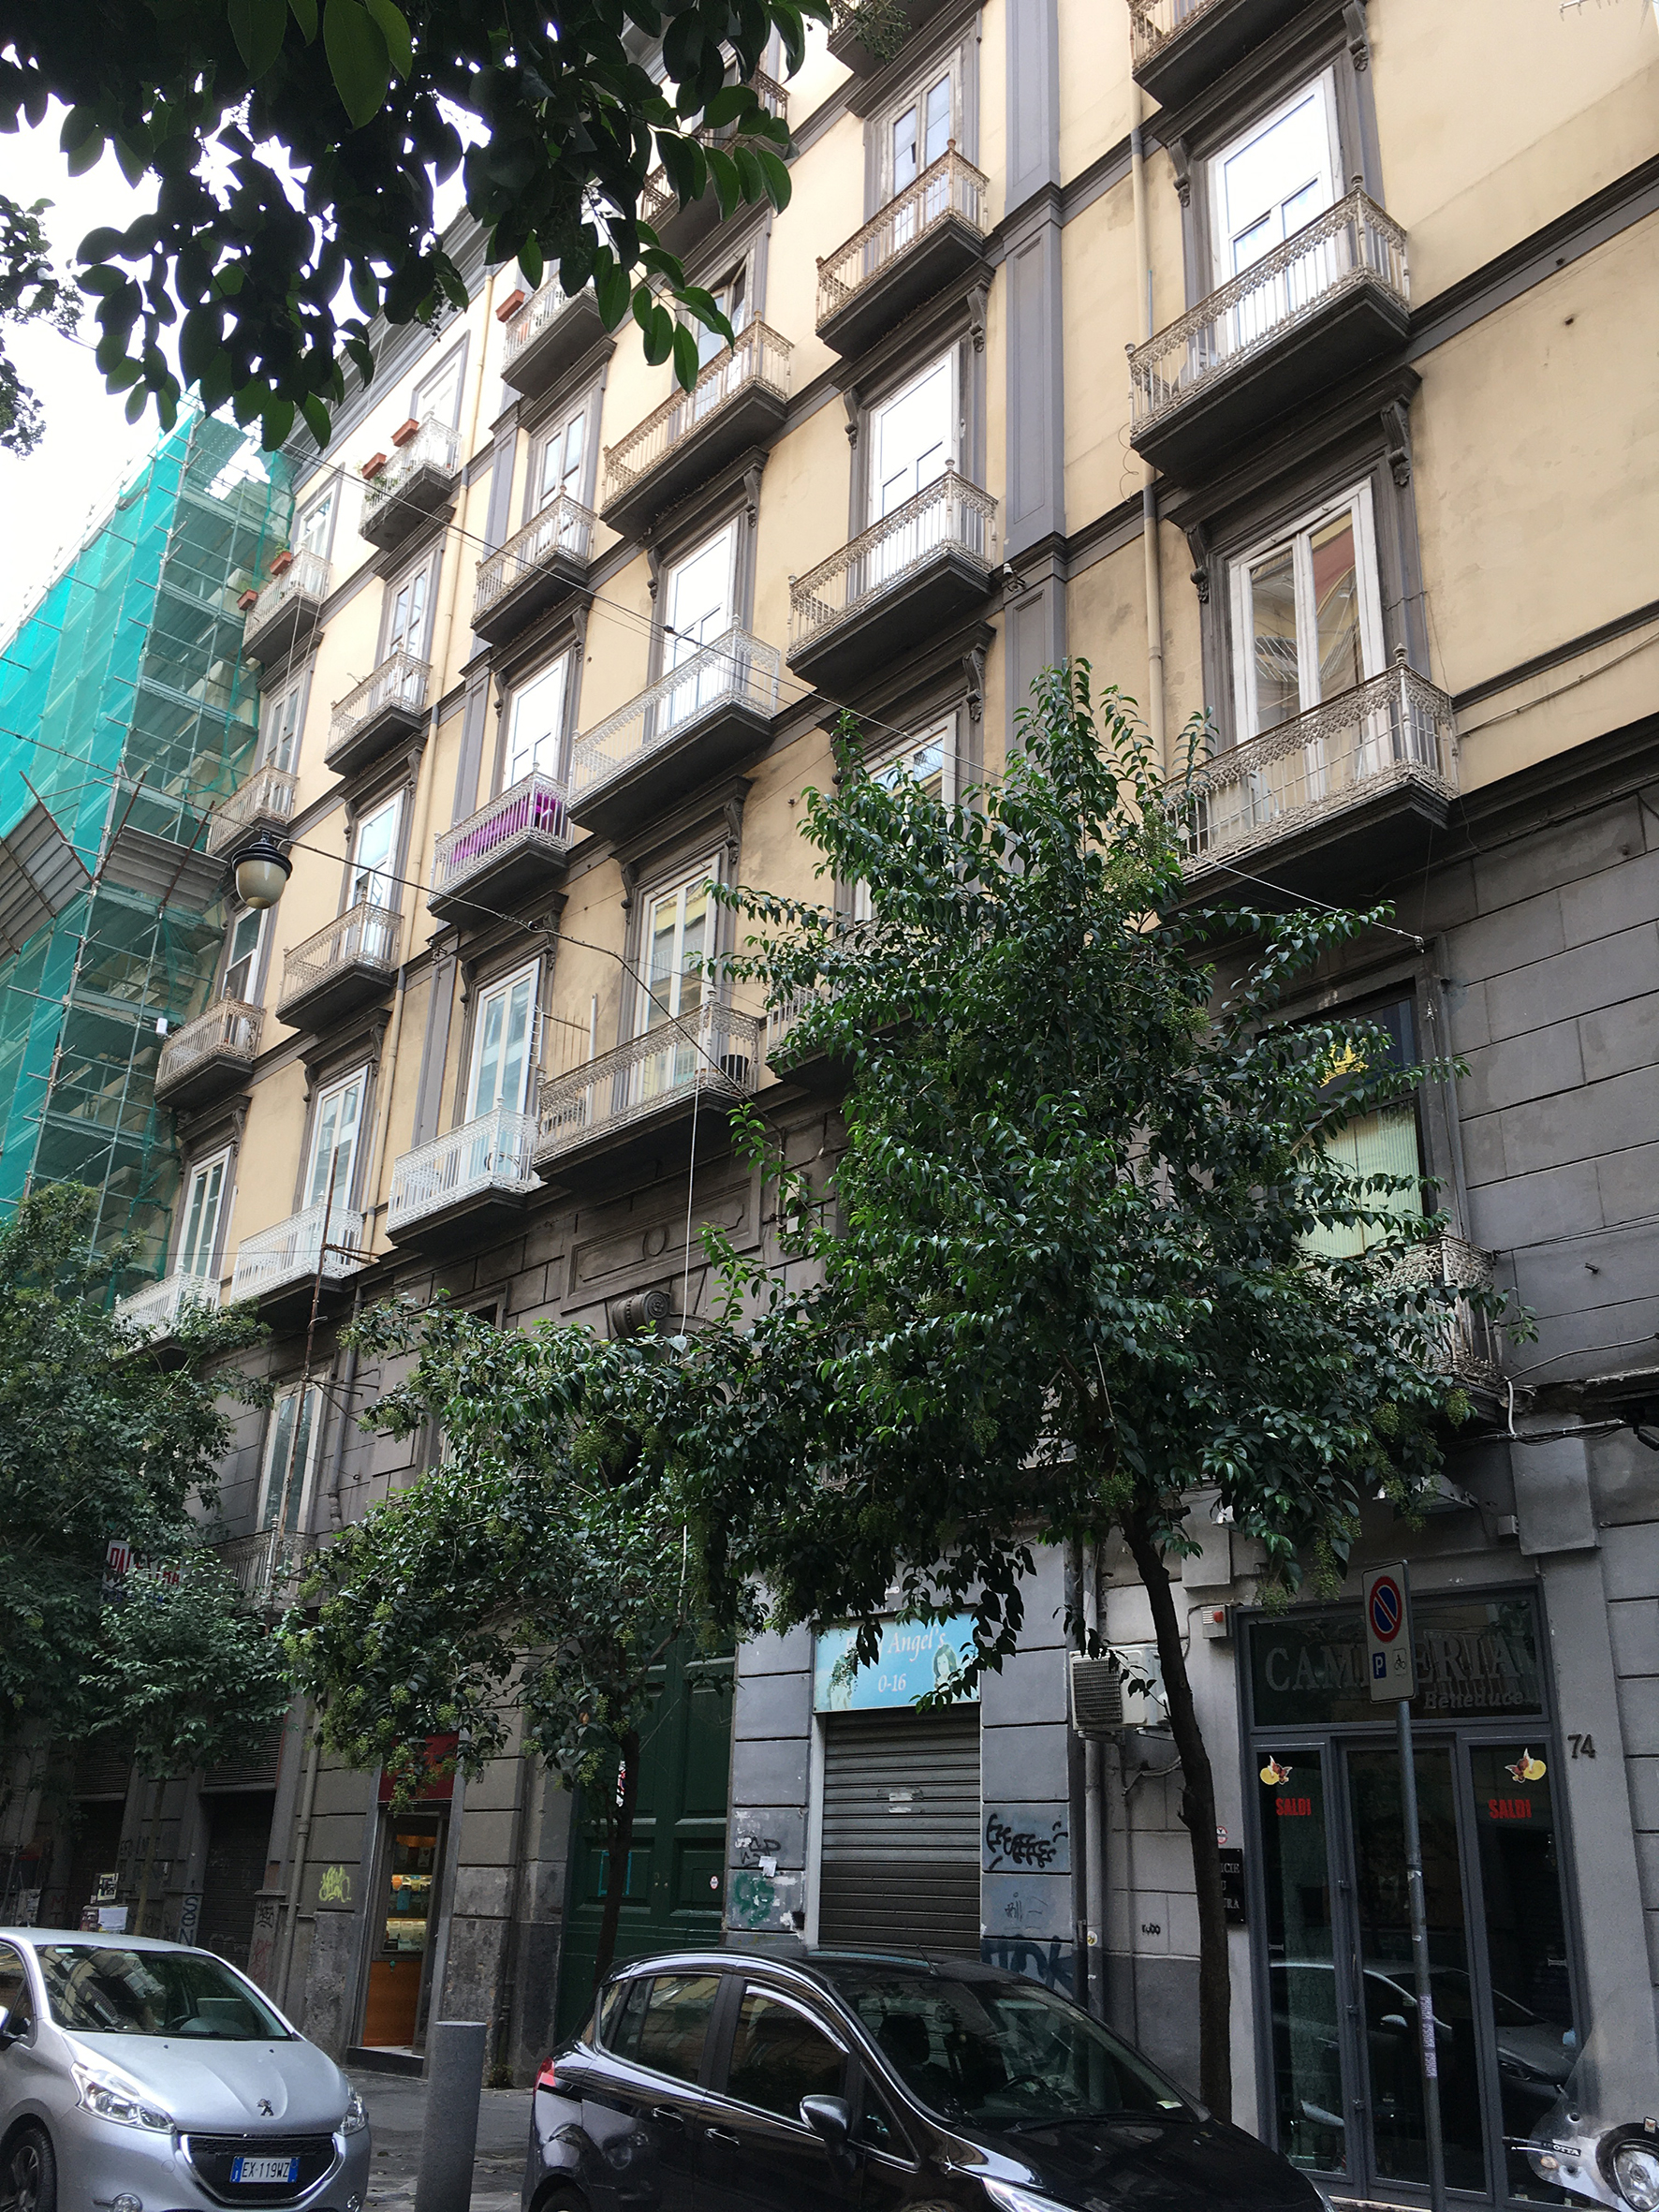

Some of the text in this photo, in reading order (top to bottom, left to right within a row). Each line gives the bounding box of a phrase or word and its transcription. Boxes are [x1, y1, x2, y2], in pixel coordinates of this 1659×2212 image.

[888, 1624, 946, 1662] Angel's
[878, 1674, 906, 1692] 0-16
[1424, 1688, 1523, 1710] Beneduce
[1567, 1733, 1596, 1760] 74
[1275, 1797, 1312, 1817] SALDI
[1489, 1799, 1533, 1820] SALDI
